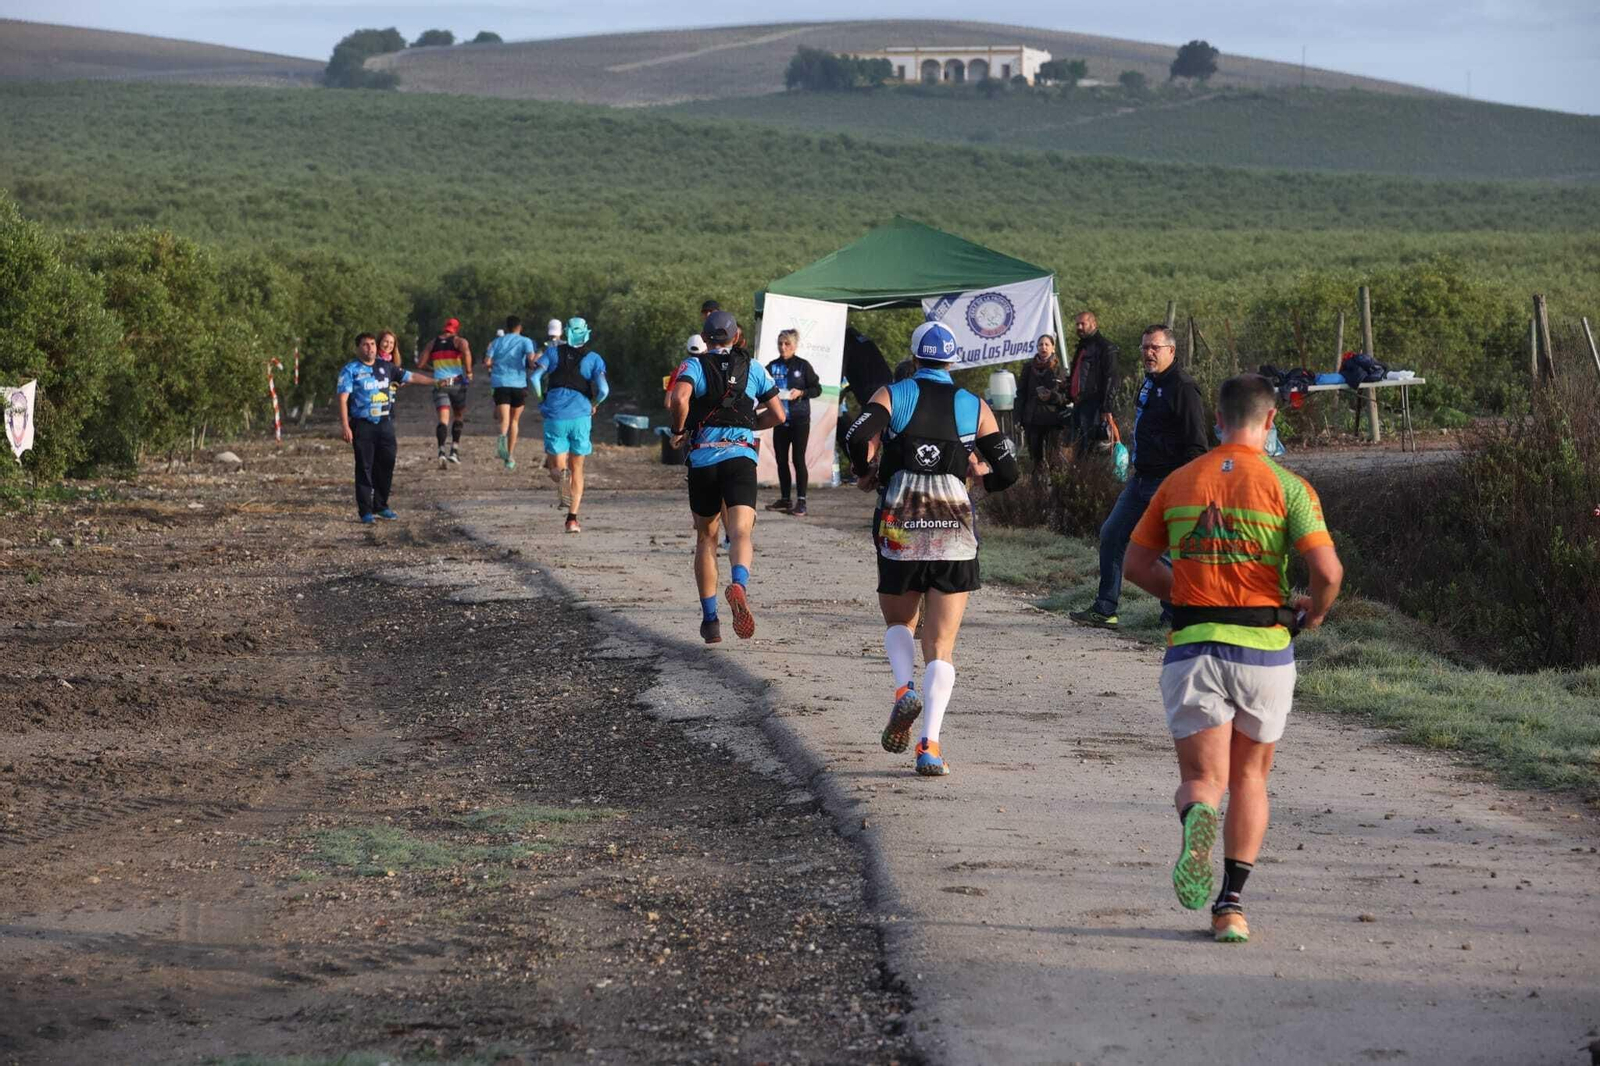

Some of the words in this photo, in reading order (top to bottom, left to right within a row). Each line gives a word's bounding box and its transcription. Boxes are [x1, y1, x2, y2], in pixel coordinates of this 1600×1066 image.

[956, 346, 981, 362] CLUB
[982, 343, 1001, 360] LOS
[1002, 339, 1035, 358] PUPAS
[903, 518, 959, 529] carbonera
